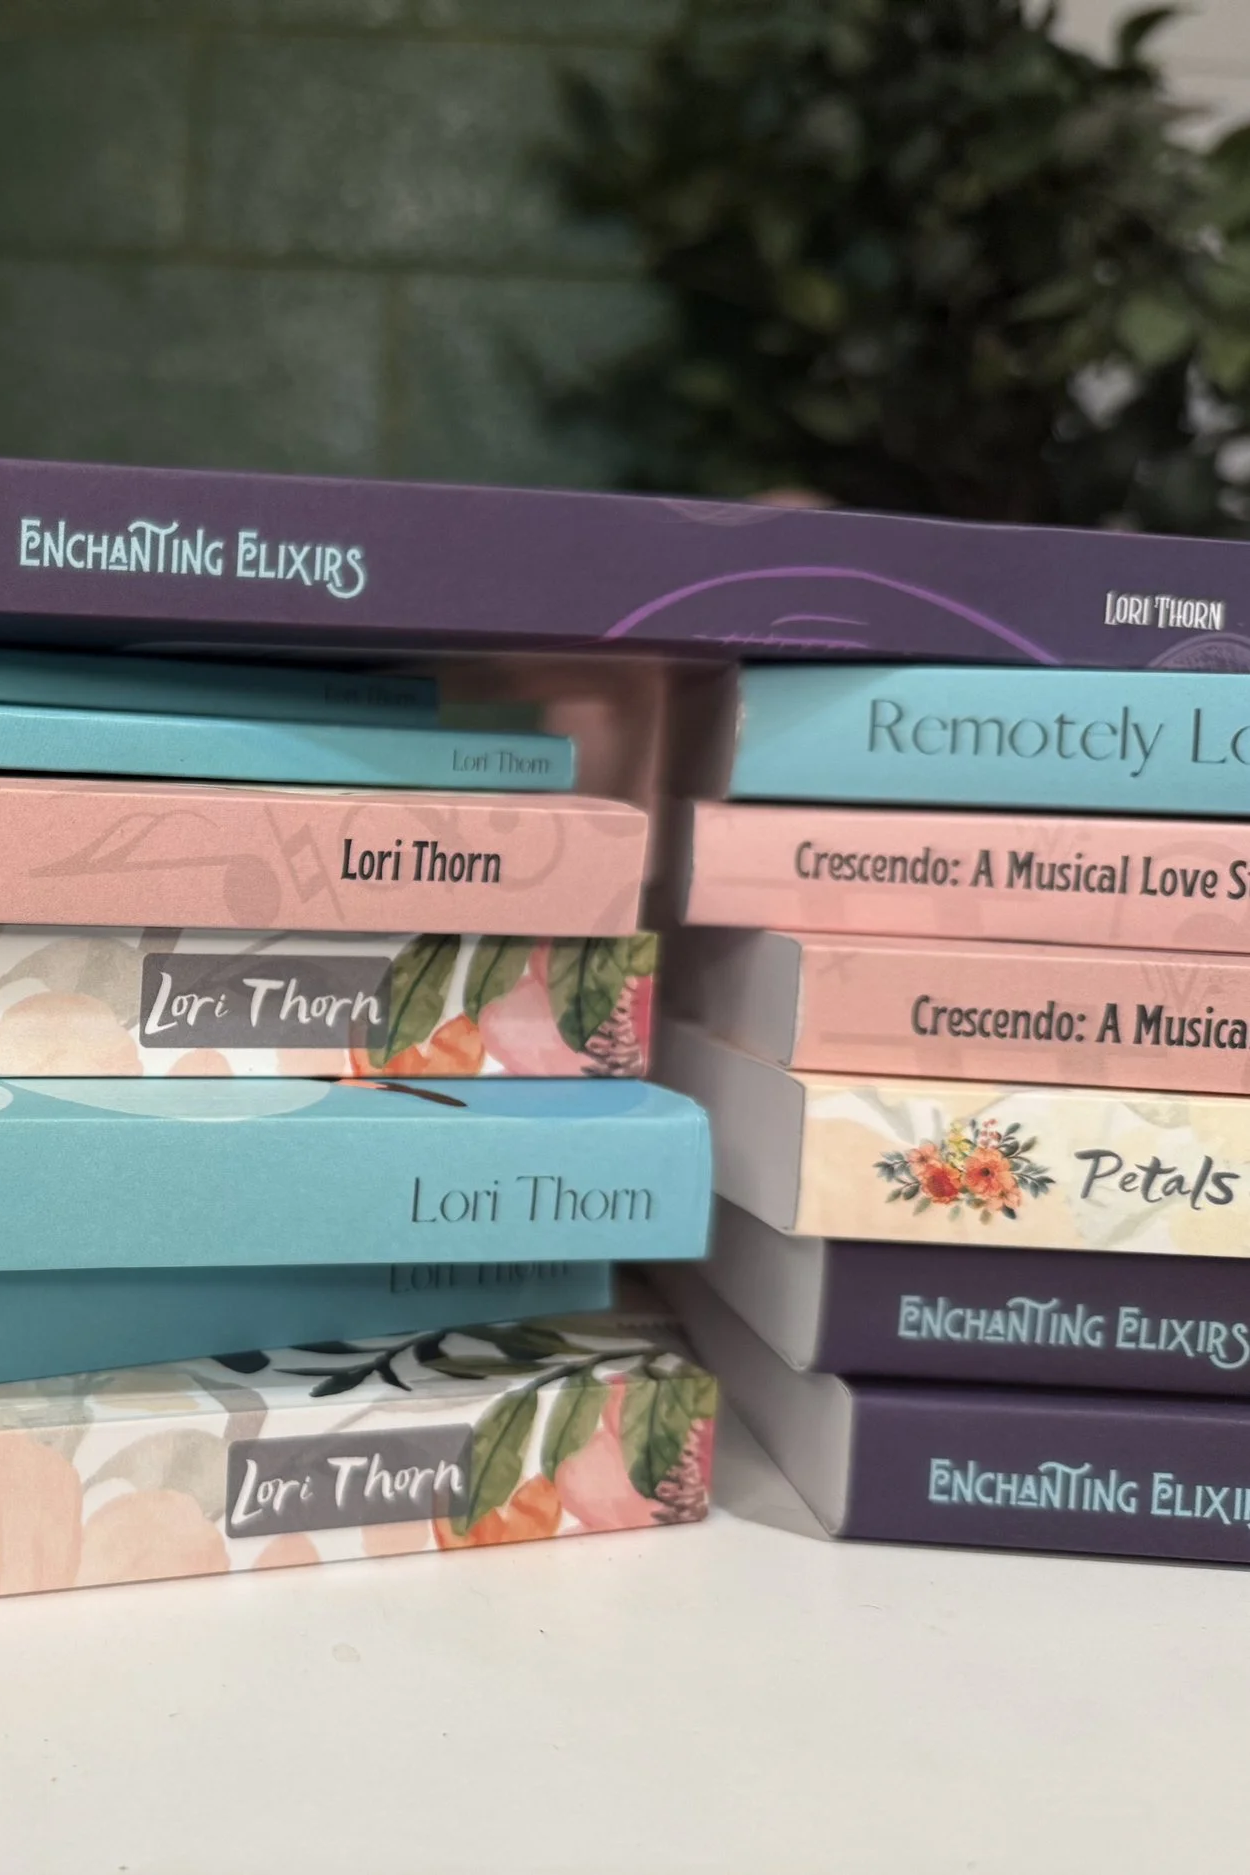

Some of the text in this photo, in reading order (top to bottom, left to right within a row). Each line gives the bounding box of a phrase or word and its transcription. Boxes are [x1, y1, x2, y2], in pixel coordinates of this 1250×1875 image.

[19, 517, 366, 599] ENCHANTING ELIXIRS
[1104, 590, 1224, 631] LORI THORN
[452, 750, 550, 775] Lori Thorn
[866, 698, 1164, 778] Remotely
[340, 838, 502, 883] Lori Thorn
[795, 841, 960, 887] Crescendo:
[969, 849, 994, 888] A
[1005, 850, 1129, 894] Musical
[1140, 856, 1218, 899] Love
[144, 971, 382, 1034] Lori Thorn
[911, 995, 1250, 1050] Crescendo: A Musica
[411, 1176, 653, 1223] Lori Thorn
[1074, 1148, 1240, 1210] Petals
[897, 1295, 1104, 1348] ENCHANTING
[230, 1453, 463, 1531] Lori Thorn
[928, 1457, 1250, 1526] ENCHANTING ELIXI
